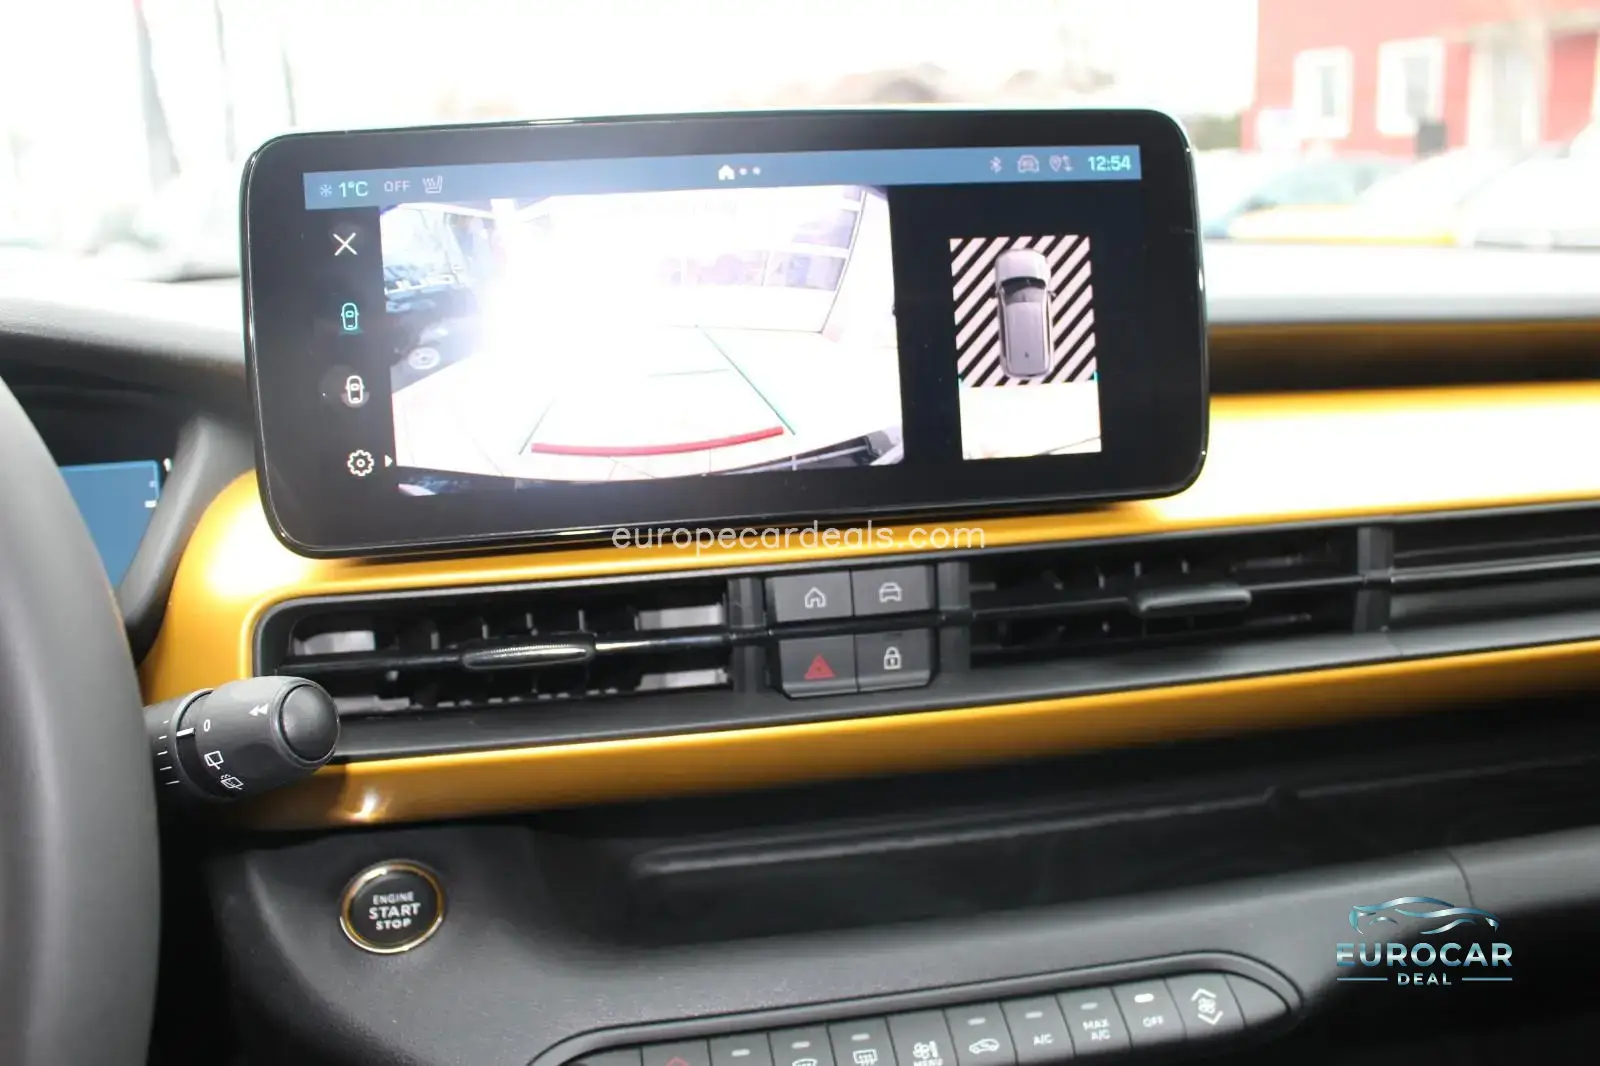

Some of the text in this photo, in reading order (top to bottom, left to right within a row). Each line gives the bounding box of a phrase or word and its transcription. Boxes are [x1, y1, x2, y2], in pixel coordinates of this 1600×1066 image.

[1087, 154, 1132, 172] 12:54
[383, 180, 412, 193] OFF
[372, 891, 415, 906] ENGINE
[368, 902, 421, 920] START
[375, 917, 412, 931] STOP
[1082, 1018, 1110, 1031] MAX
[1142, 1015, 1164, 1028] OFF
[1033, 1033, 1054, 1046] A/C
[1090, 1029, 1111, 1041] A/C
